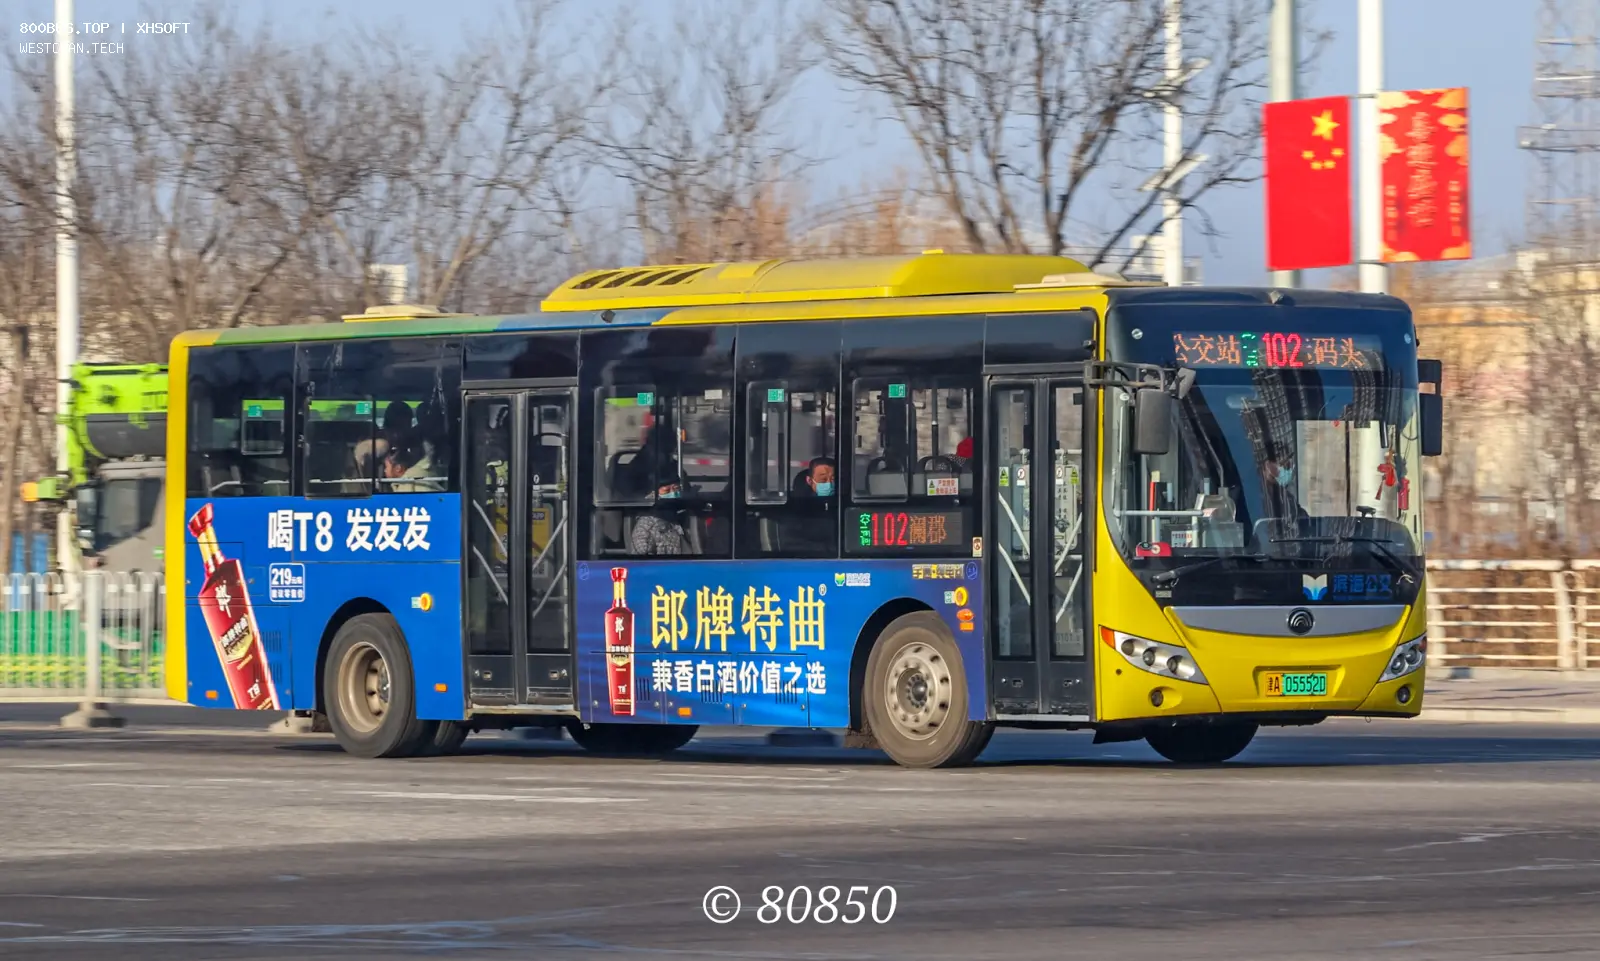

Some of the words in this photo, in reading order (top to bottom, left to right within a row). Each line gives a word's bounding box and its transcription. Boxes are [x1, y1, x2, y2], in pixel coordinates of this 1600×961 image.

[1262, 332, 1304, 367] 102
[268, 509, 333, 552] 喝T8
[346, 506, 431, 551] 发发发
[872, 512, 908, 546] 102
[651, 585, 826, 652] 郎牌特曲
[652, 659, 827, 694] 兼香白酒价值之选
